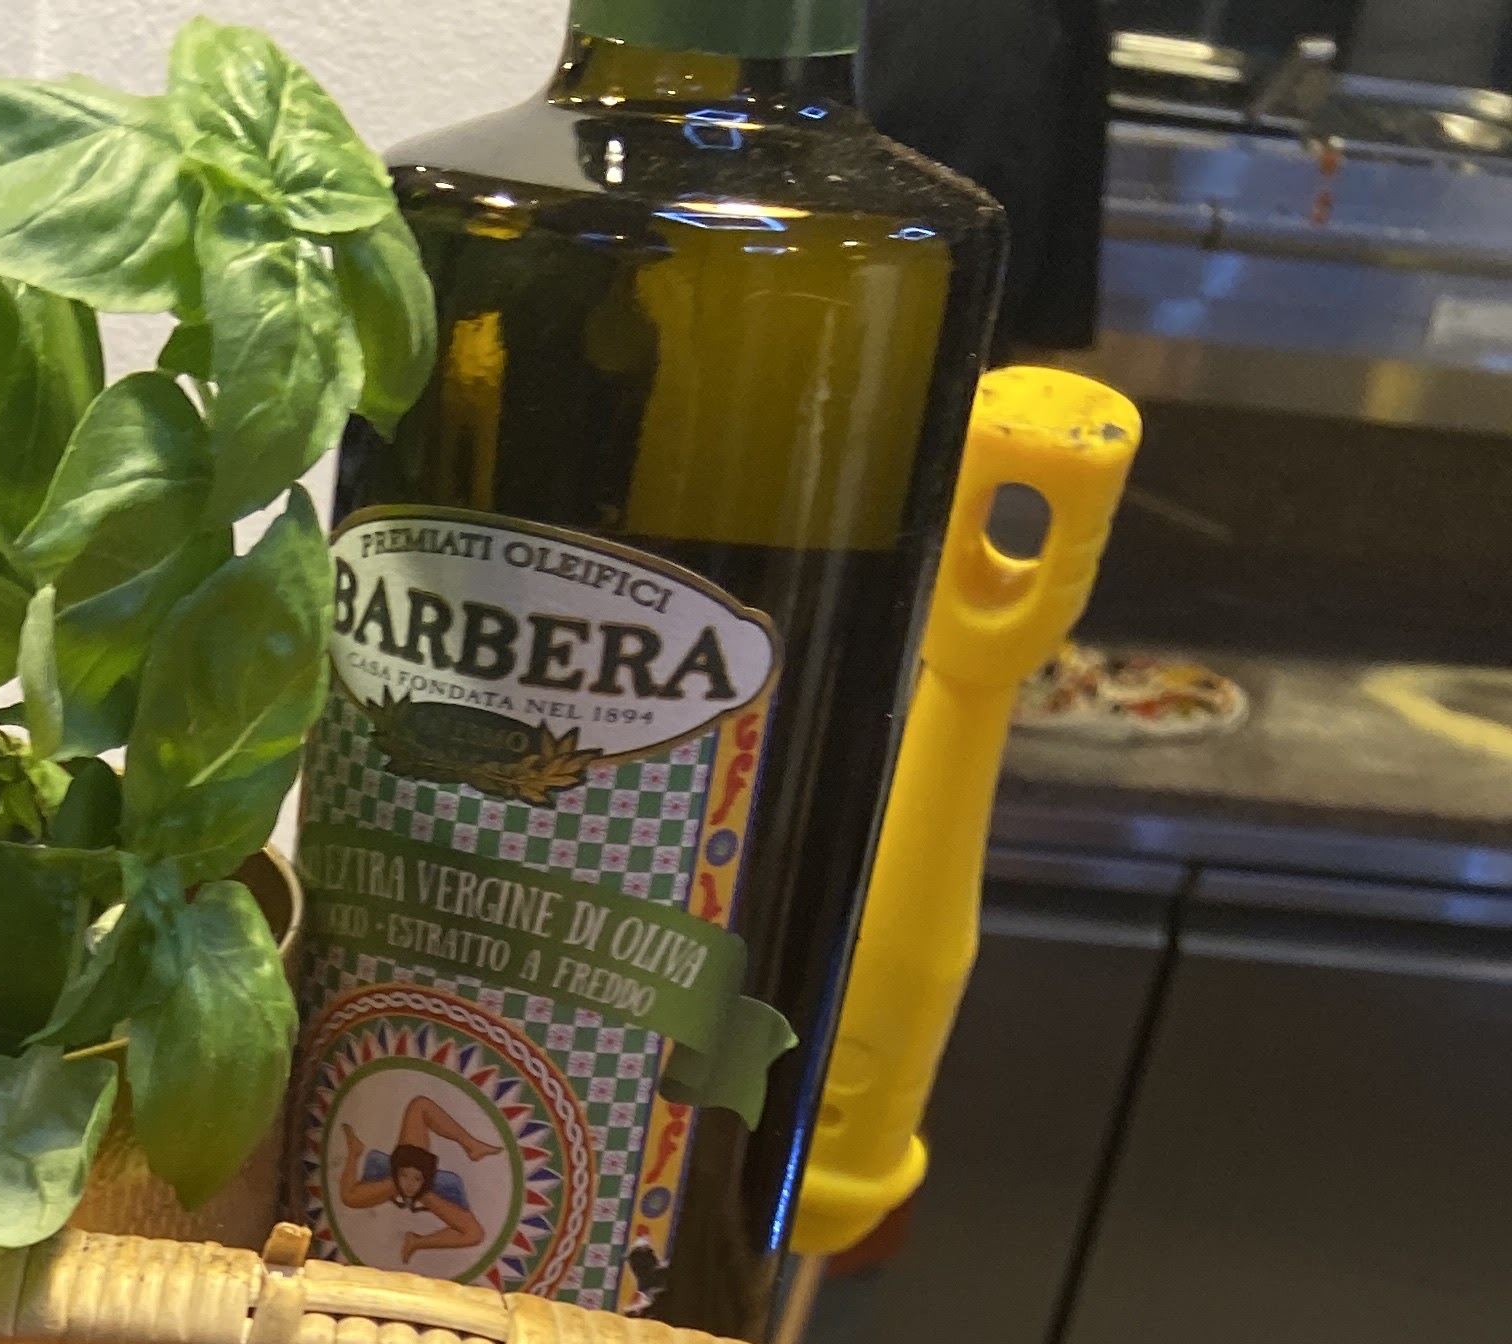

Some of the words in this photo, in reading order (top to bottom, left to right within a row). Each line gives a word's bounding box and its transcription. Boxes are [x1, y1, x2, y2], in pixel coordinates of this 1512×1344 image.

[360, 527, 493, 561] PREMIATI
[503, 540, 675, 615] OLEIFICI
[334, 555, 737, 701] BARBERA
[347, 651, 392, 681] CASA
[398, 670, 515, 712] FONDATA
[524, 696, 582, 721] NEL
[591, 706, 655, 726] 1894
[388, 912, 511, 973] ESTRATTO
[519, 948, 542, 983] A
[551, 955, 657, 1018] FREDDO
[416, 859, 563, 939] VERGINE
[563, 900, 612, 952] DI
[610, 916, 709, 989] OLIVA
